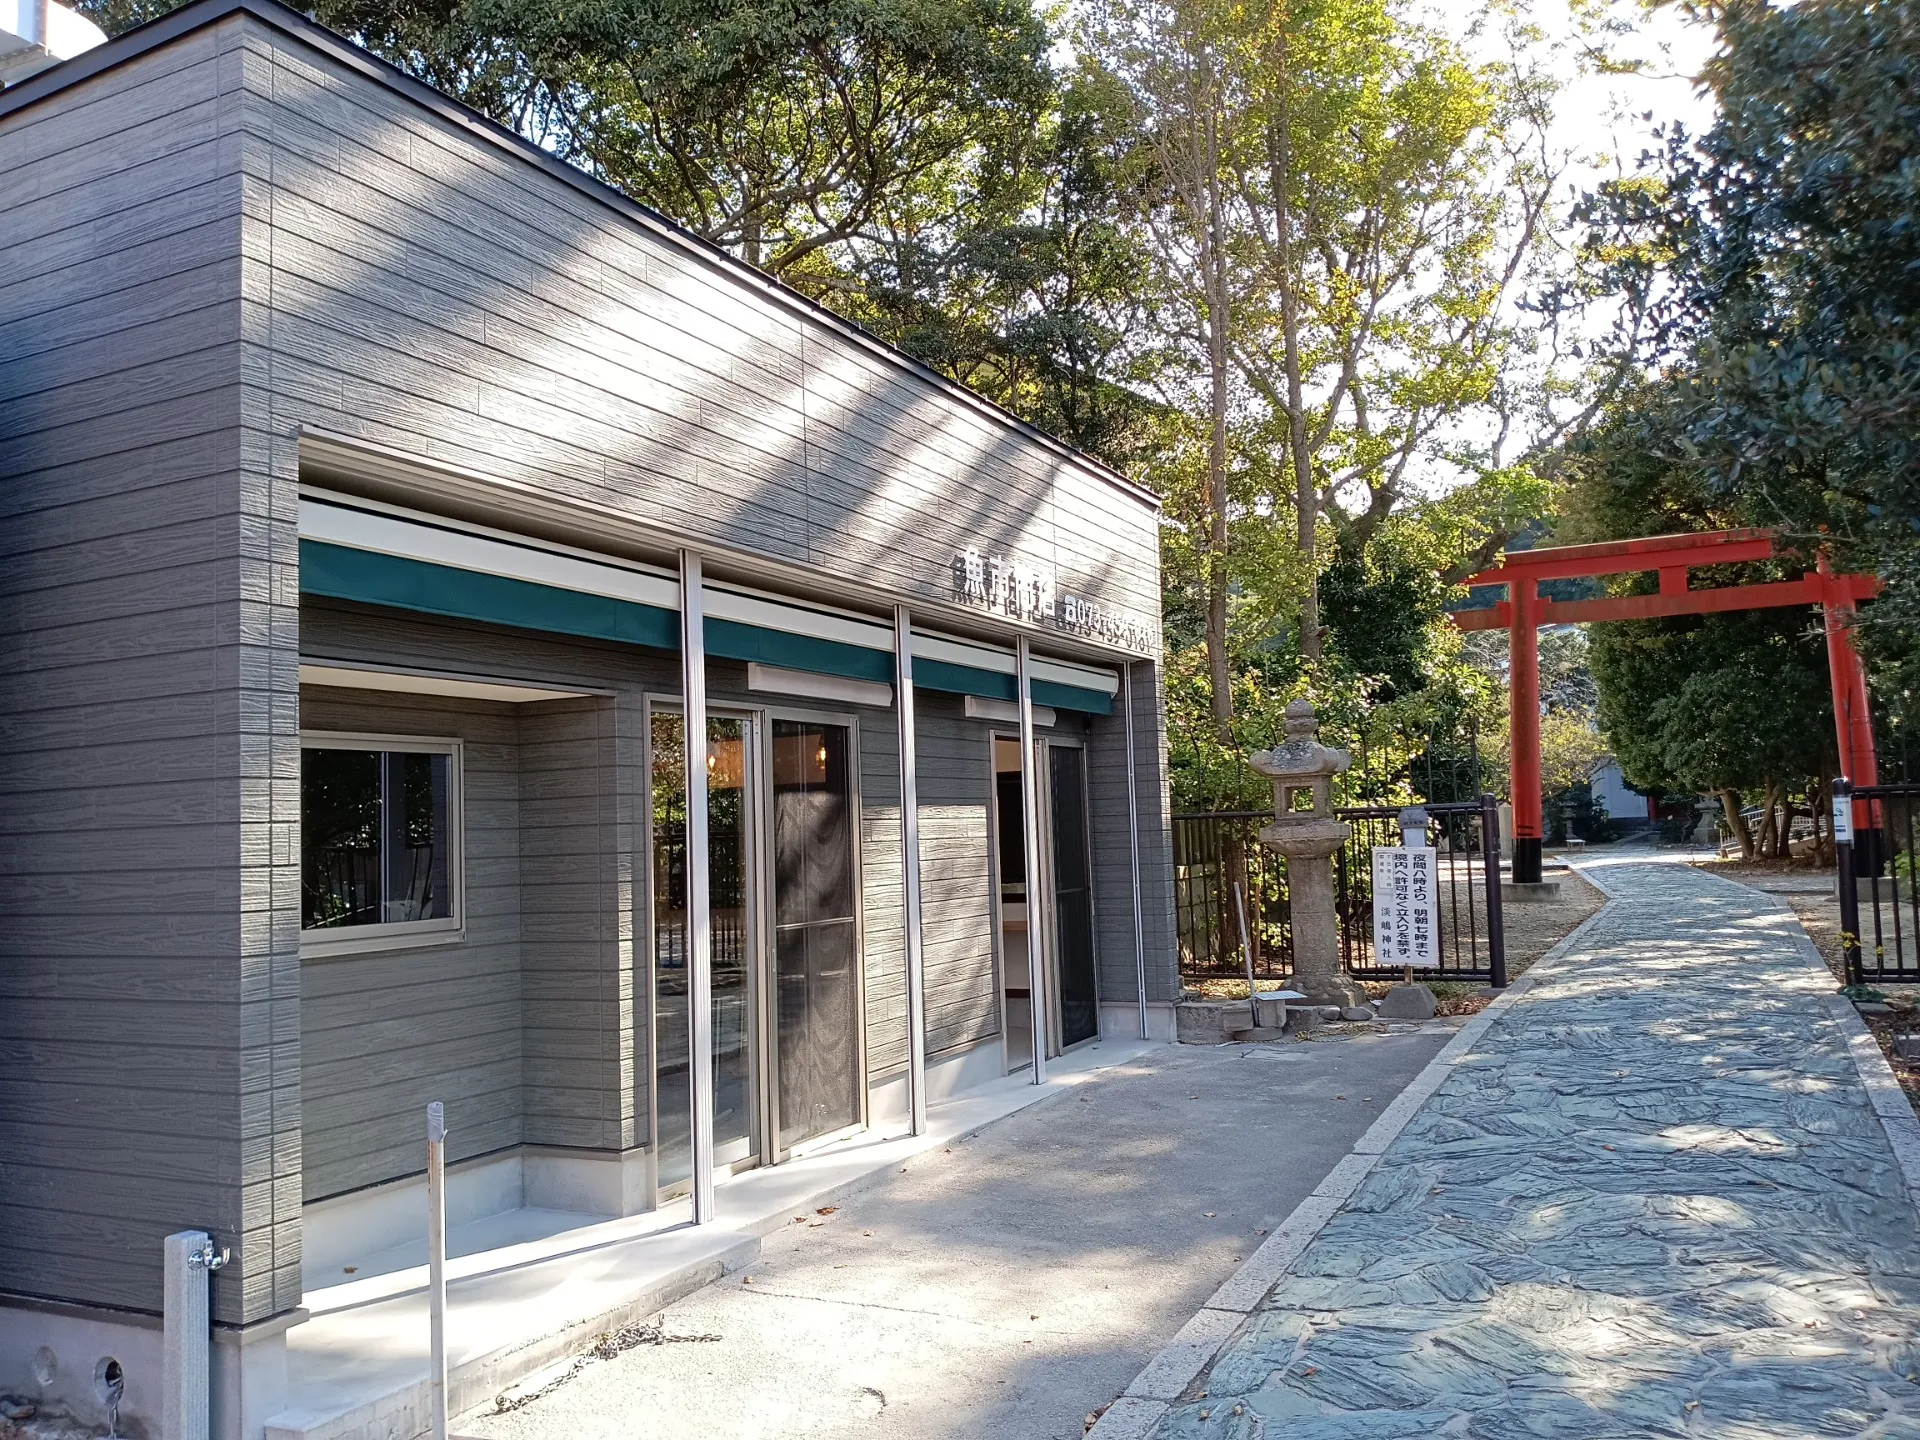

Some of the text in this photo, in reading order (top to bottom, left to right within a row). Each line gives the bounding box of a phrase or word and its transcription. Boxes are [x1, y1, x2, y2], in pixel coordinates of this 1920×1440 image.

[1381, 906, 1392, 959] 淡嶋神社
[1412, 853, 1428, 958] 夜間八時より、明朝七時まで
